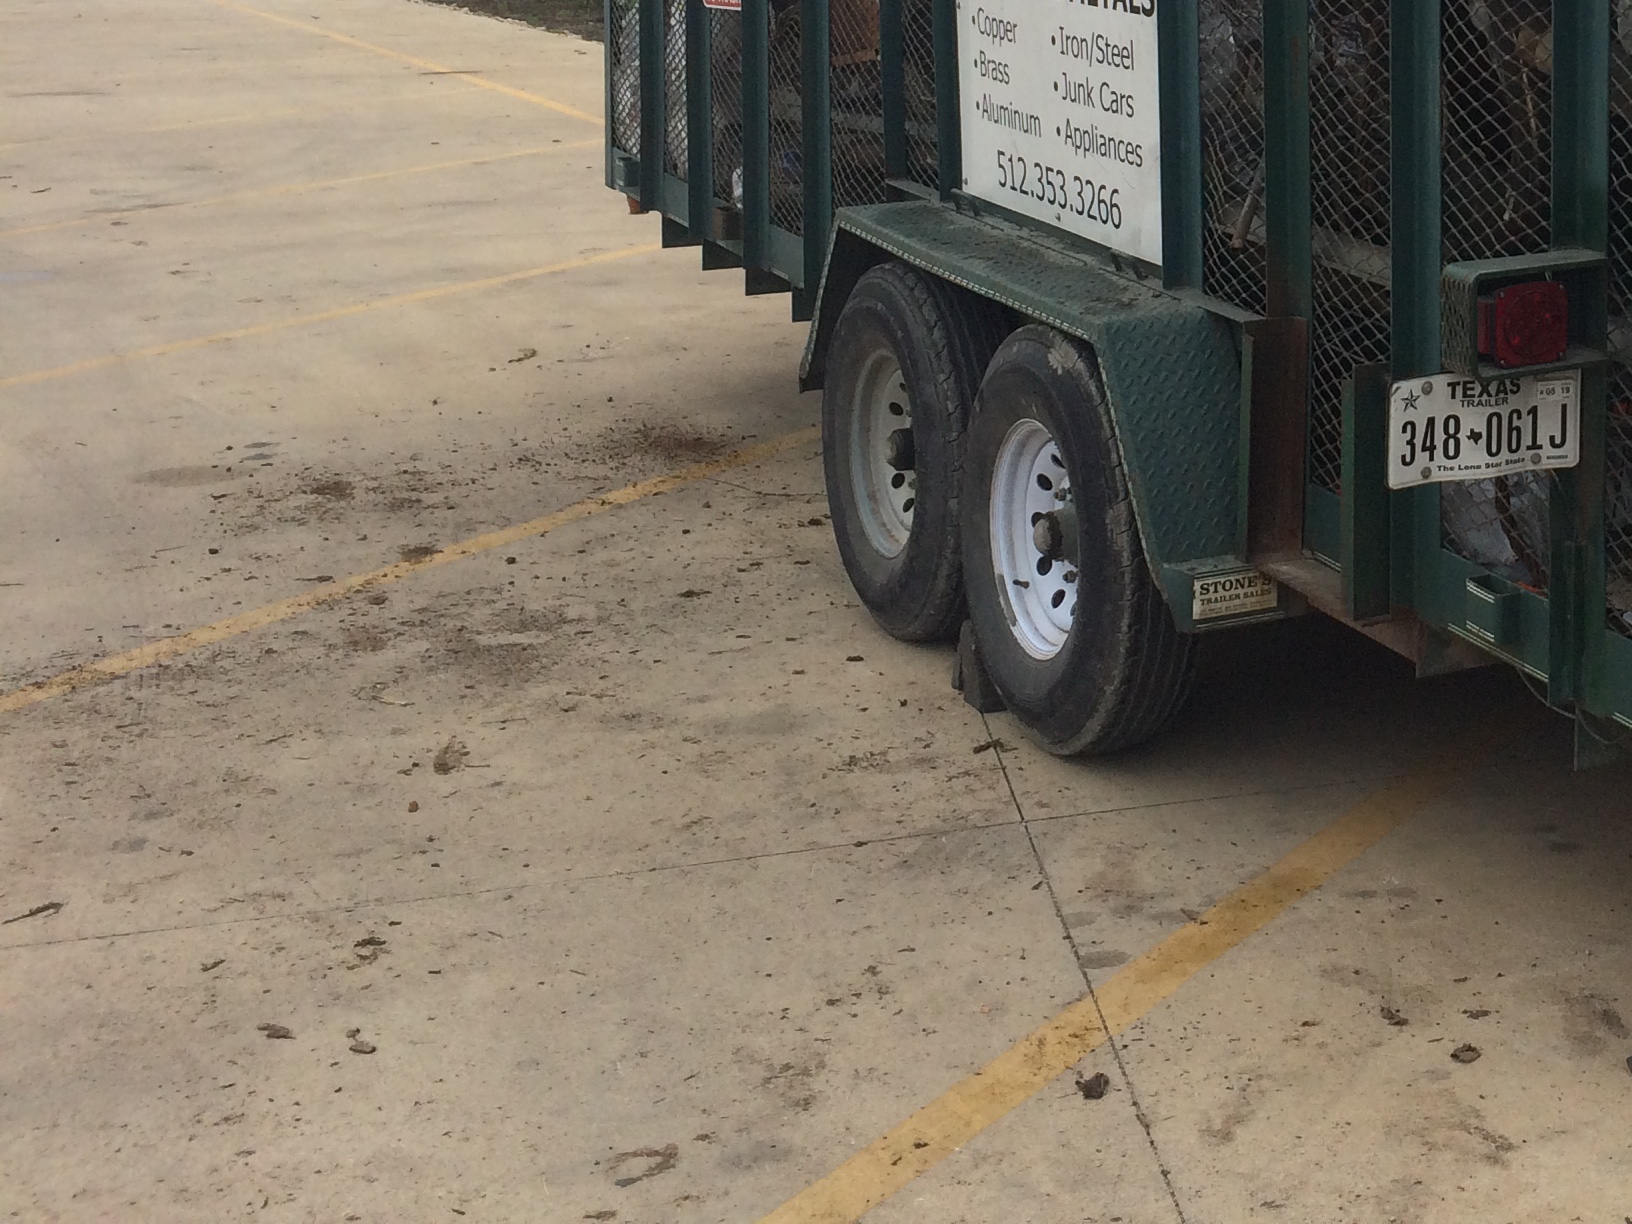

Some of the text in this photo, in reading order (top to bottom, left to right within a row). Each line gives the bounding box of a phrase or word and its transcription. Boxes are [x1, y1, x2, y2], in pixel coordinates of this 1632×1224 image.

[976, 7, 1018, 47] Copper
[979, 49, 1011, 86] Brass
[1059, 26, 1135, 71] Iron/Steel
[1061, 72, 1135, 118] Junk Cars
[981, 93, 1042, 138] Aluminum
[1064, 118, 1144, 168] Appliances
[997, 149, 1123, 230] 512.353.3266
[1447, 377, 1522, 400] TEXAS
[1459, 396, 1510, 408] TRAILER
[1400, 402, 1569, 467] 348 061J
[1436, 456, 1526, 472] The Lone Star State
[1199, 575, 1273, 596] STONE'S
[1199, 587, 1272, 606] TRAILER SALES
